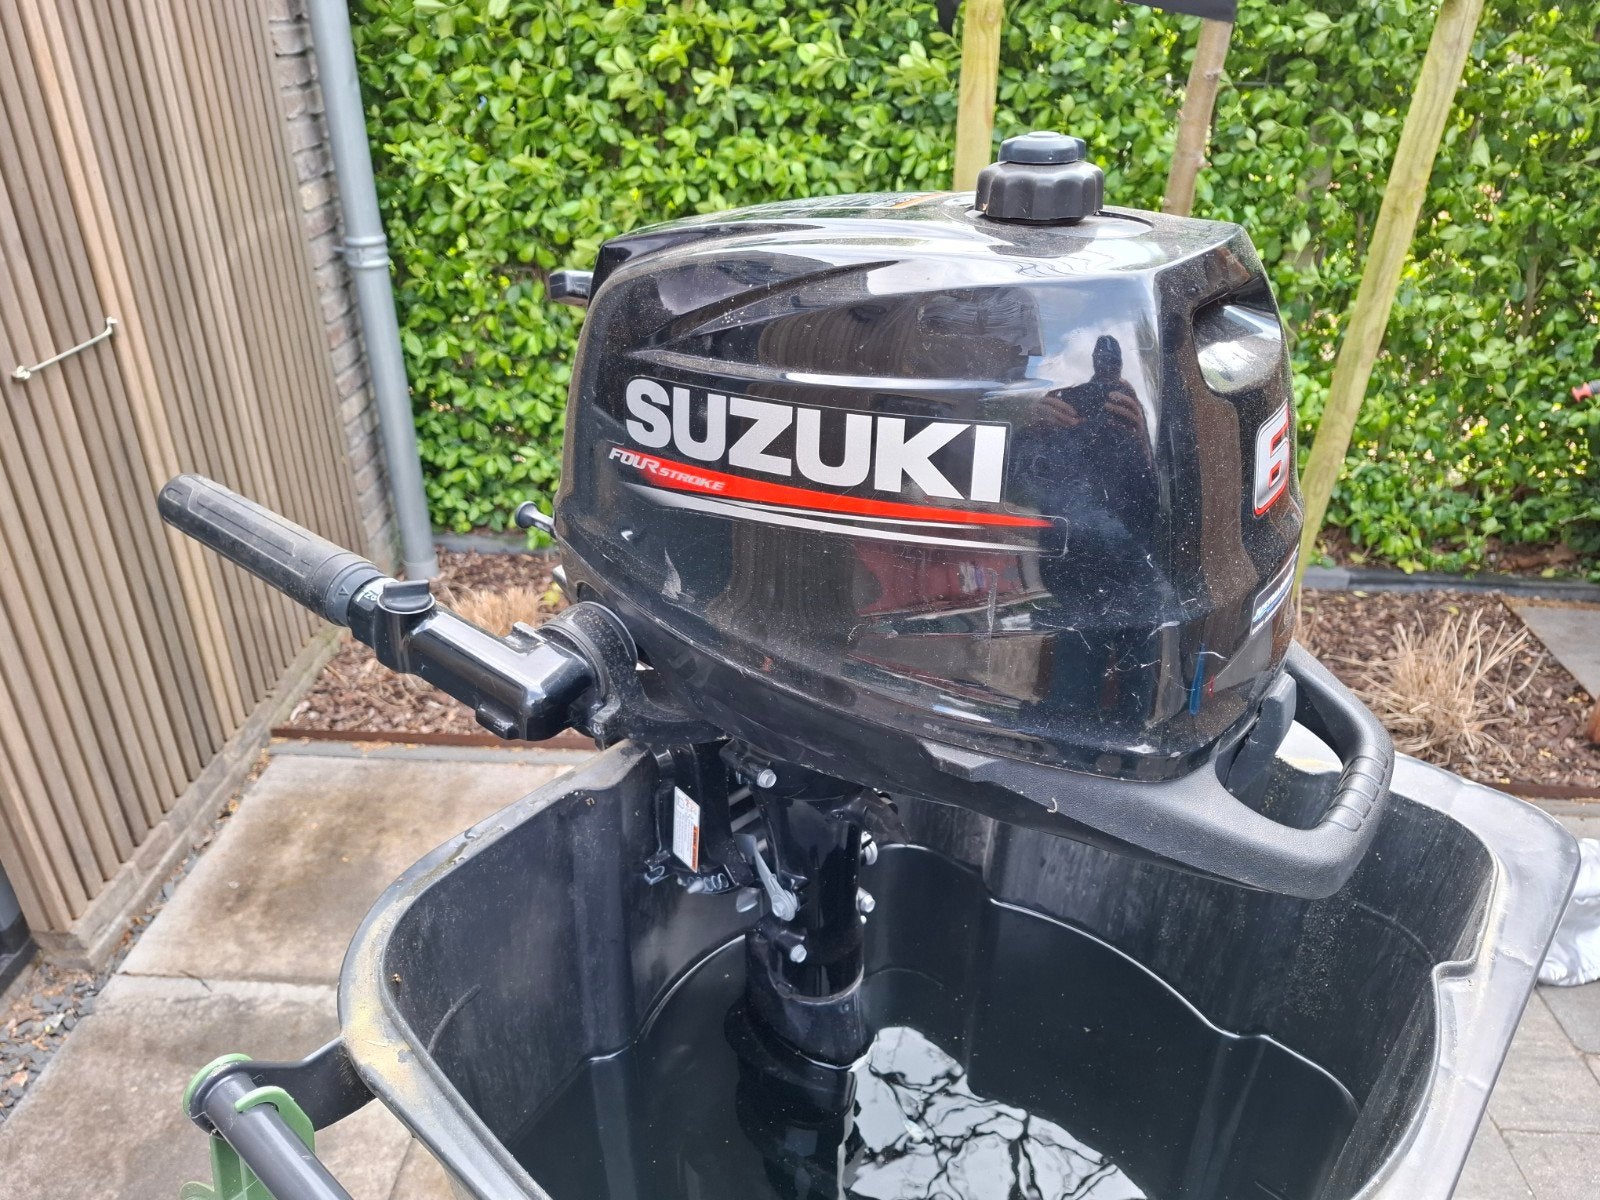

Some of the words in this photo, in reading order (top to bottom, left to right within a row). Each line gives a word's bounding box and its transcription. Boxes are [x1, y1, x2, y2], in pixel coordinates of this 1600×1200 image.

[608, 447, 660, 474] FOUR
[658, 467, 726, 491] STROKE
[625, 378, 1006, 503] SUZUKI
[1254, 400, 1289, 516] 6
